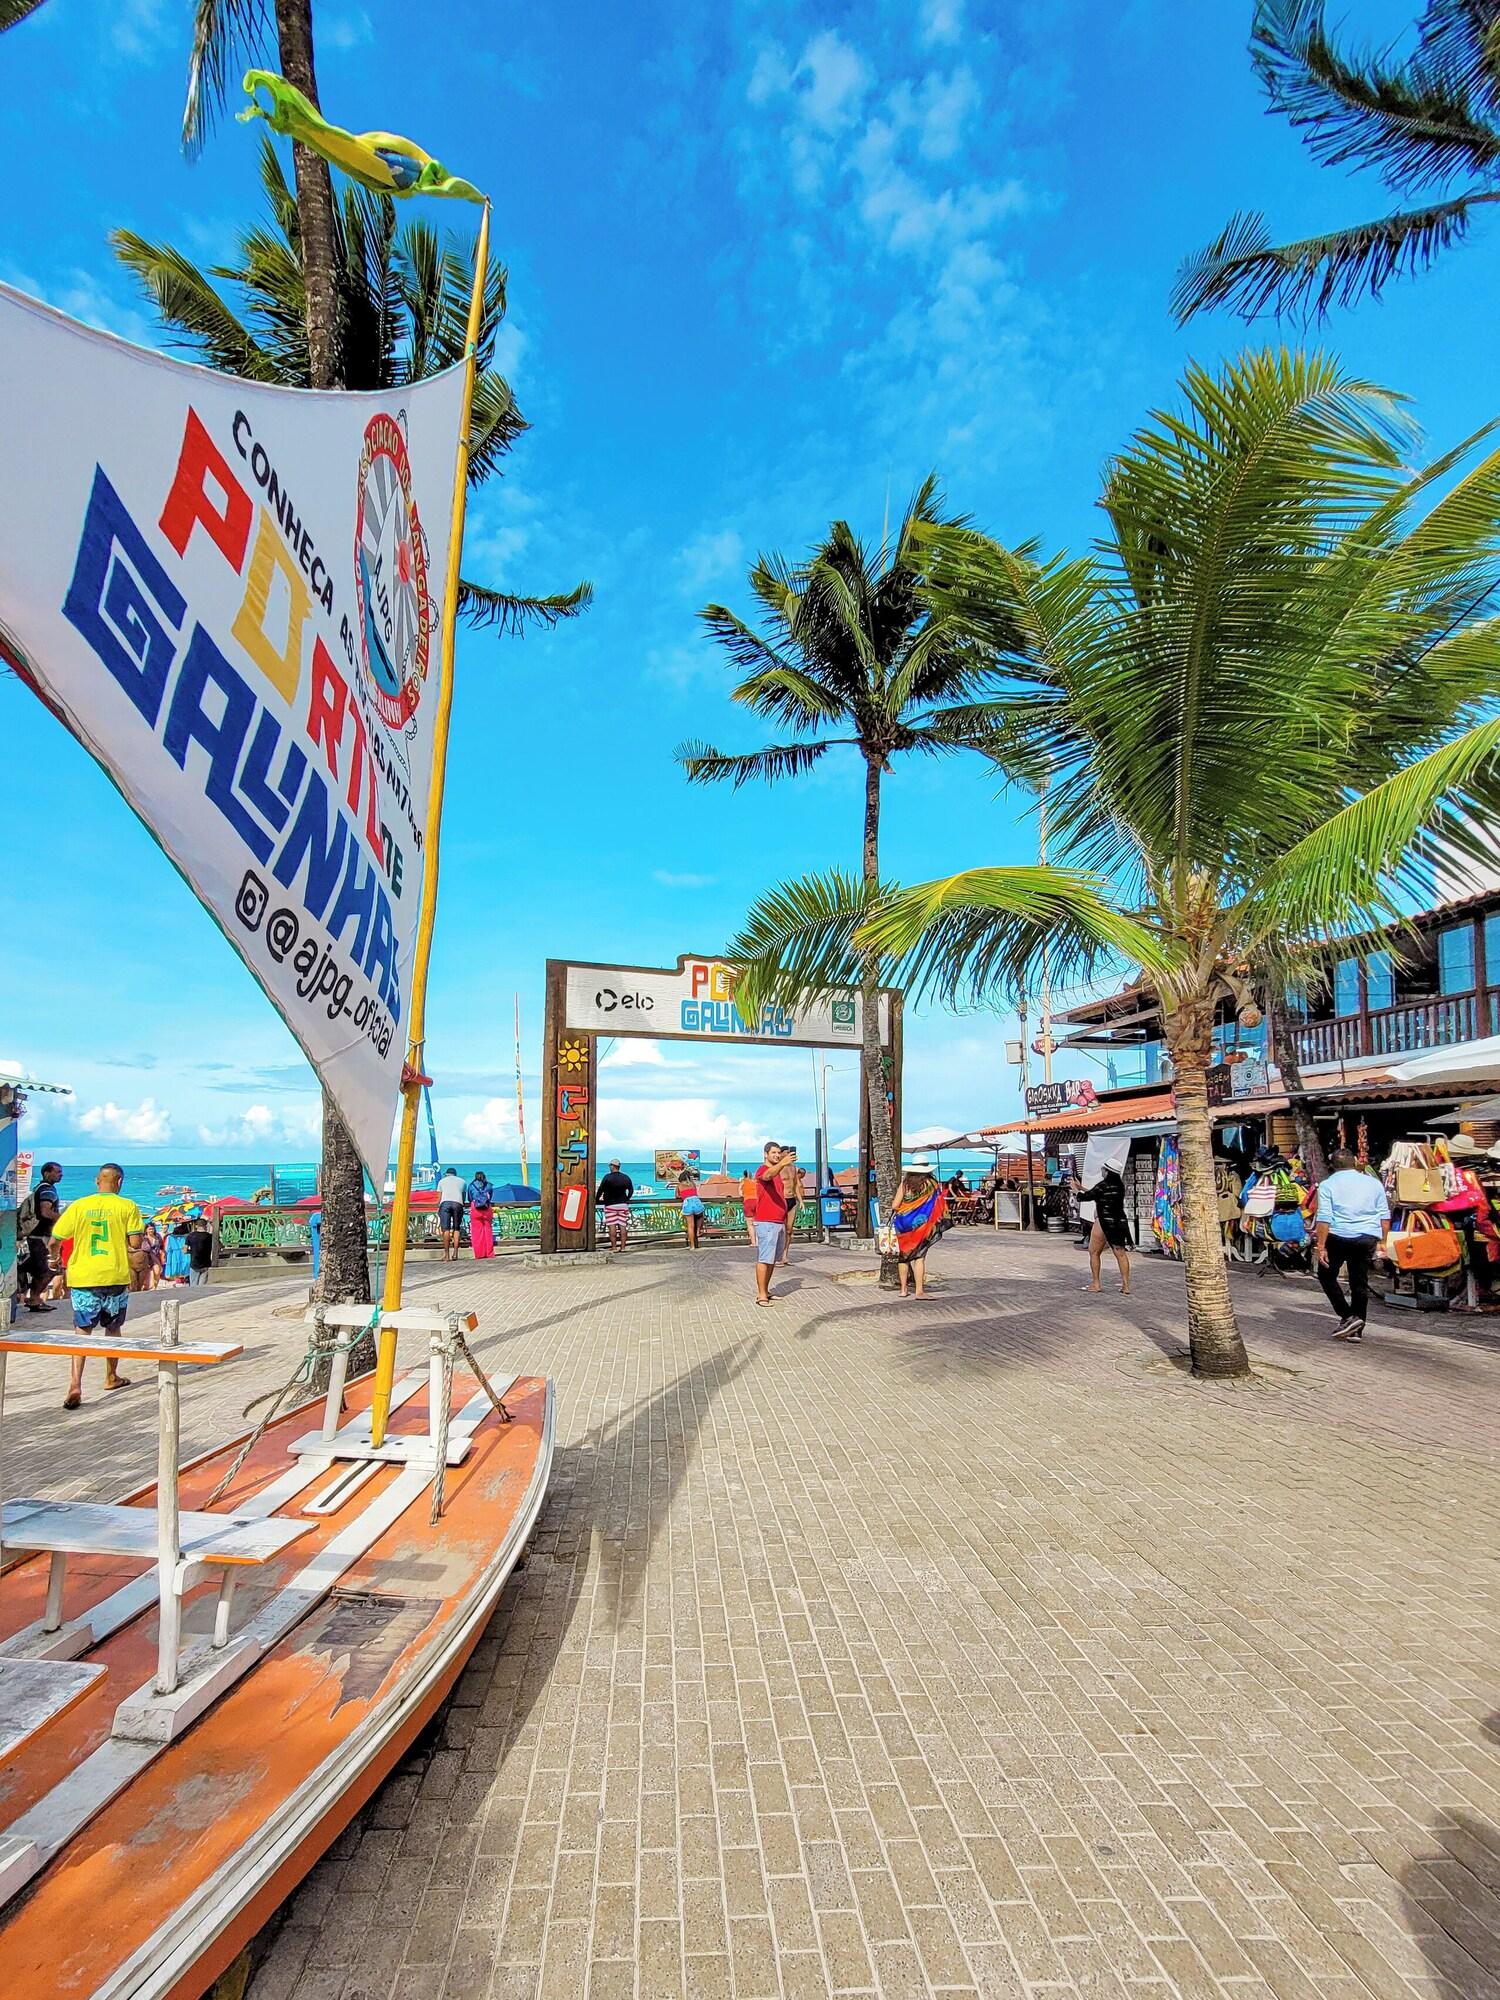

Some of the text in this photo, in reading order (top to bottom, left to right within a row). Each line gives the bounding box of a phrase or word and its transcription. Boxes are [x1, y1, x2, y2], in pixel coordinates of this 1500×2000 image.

[232, 410, 335, 615] CONHEÇA
[374, 553, 393, 644] AJPG
[1065, 1080, 1082, 1101] BAR
[90, 1219, 109, 1257] 2
